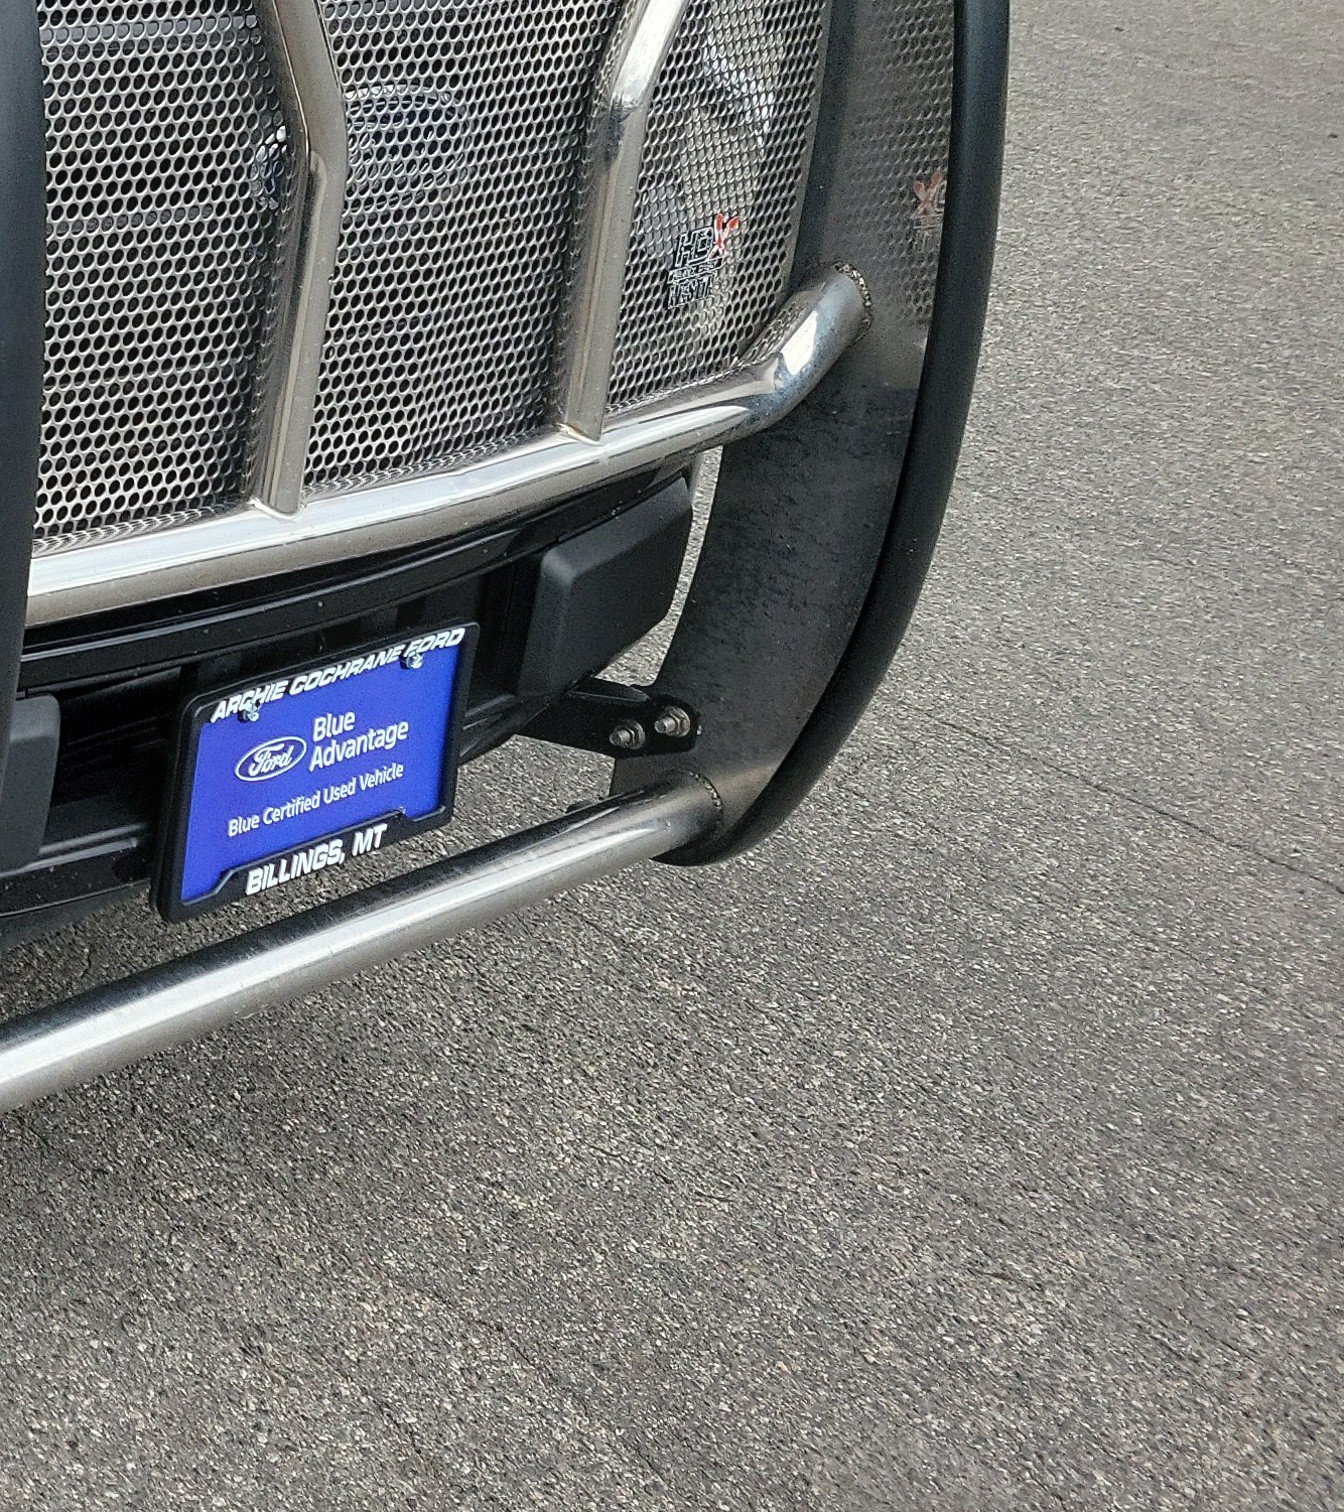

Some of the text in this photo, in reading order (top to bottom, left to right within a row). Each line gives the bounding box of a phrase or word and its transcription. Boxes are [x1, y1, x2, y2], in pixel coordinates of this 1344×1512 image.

[210, 628, 465, 724] ARCHIE COCHRANE FORD
[309, 721, 409, 772] Advantage
[313, 711, 356, 742] Blue
[248, 743, 294, 777] Ford
[227, 762, 404, 837] Blue Certified Used Vehicle
[246, 823, 388, 895] BILLINGS, MT
